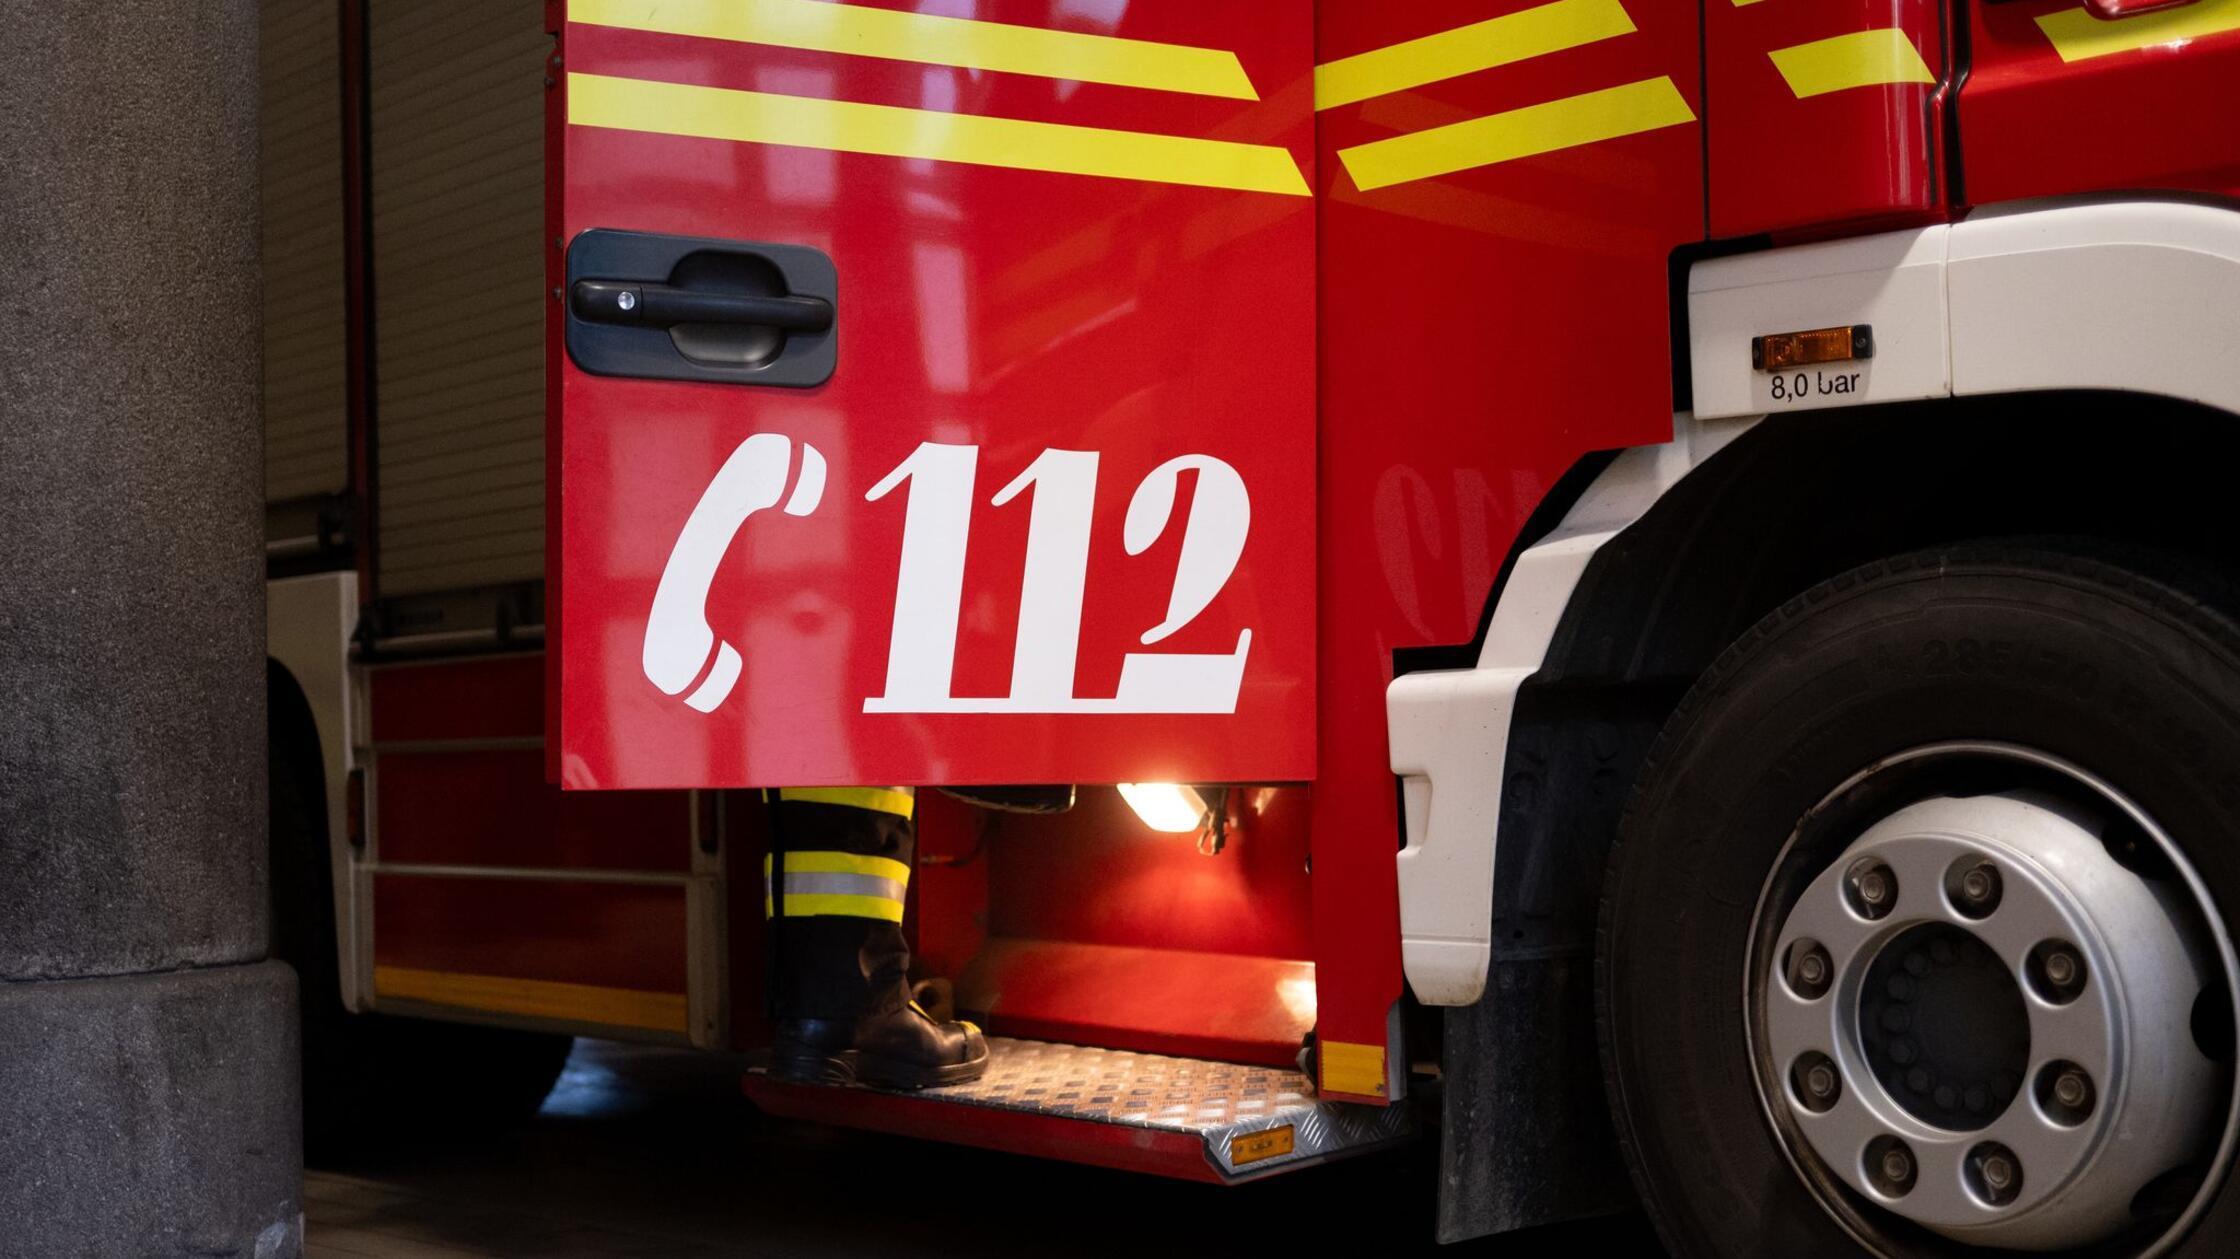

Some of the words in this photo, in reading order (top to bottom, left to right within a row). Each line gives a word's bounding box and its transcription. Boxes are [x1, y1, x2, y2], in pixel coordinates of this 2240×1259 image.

[1771, 373, 1808, 402] 8,0
[1817, 371, 1860, 395] bar
[863, 442, 1252, 714] 112
